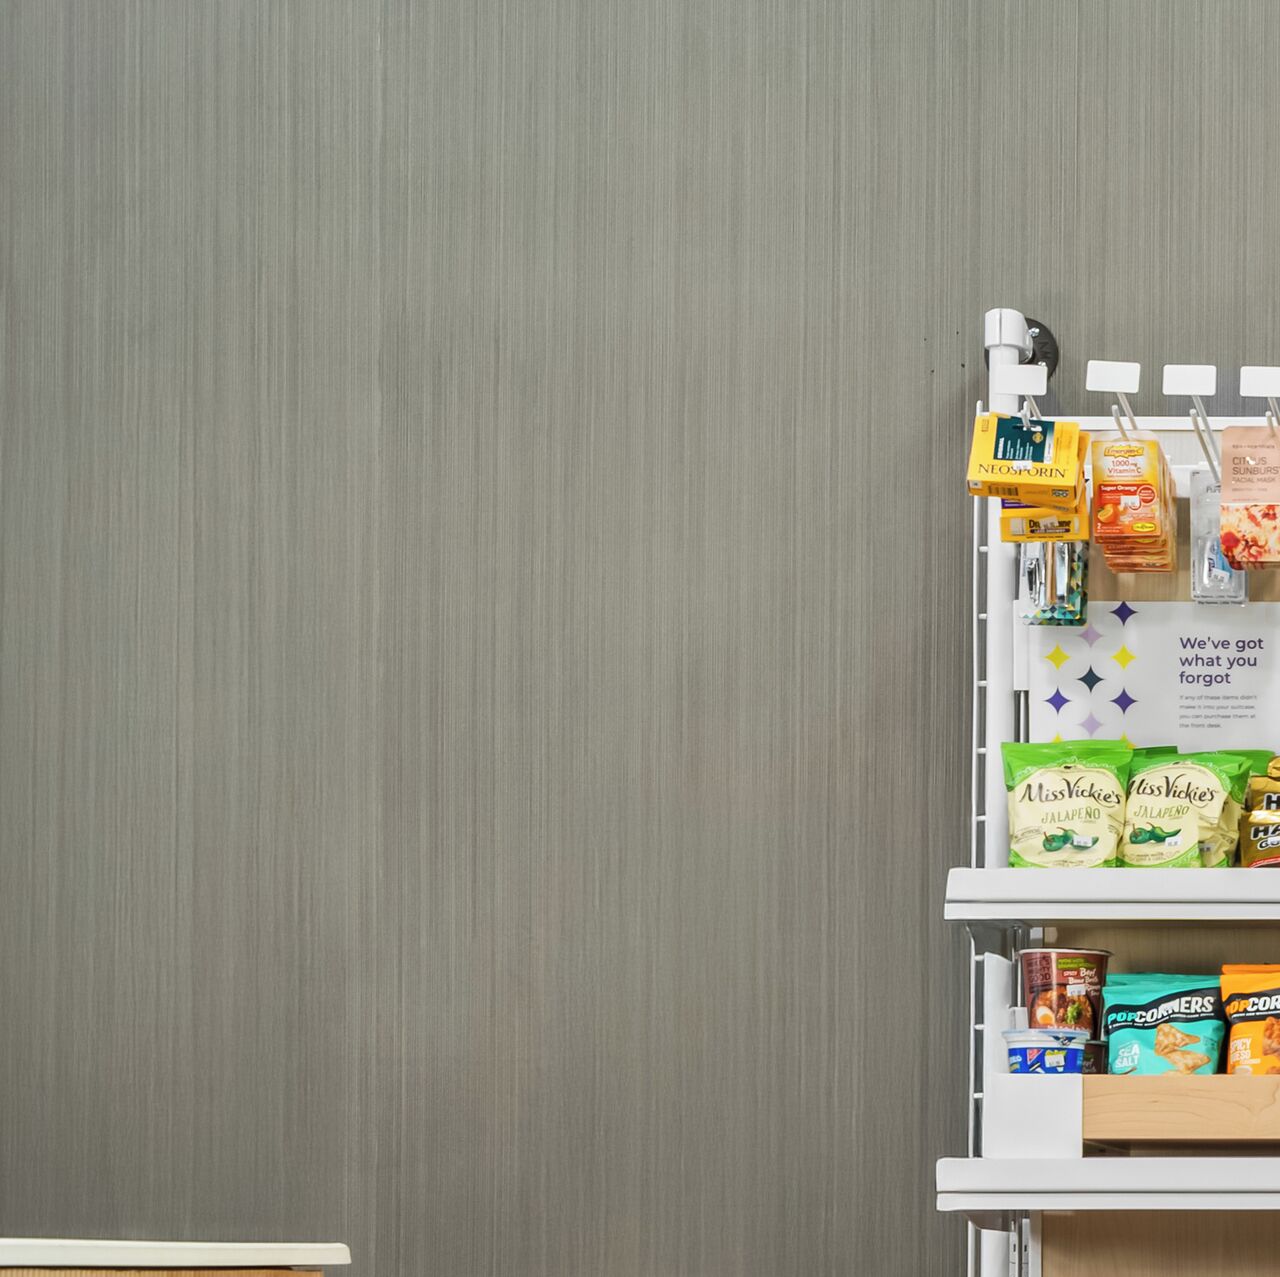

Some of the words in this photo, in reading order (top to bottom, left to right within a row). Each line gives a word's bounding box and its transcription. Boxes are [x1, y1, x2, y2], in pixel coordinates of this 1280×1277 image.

[978, 463, 1066, 478] NEOSPORIN
[1107, 467, 1135, 475] Vitamin
[1179, 637, 1230, 650] We've
[1236, 638, 1264, 653] got
[1179, 654, 1222, 667] what
[1227, 657, 1257, 670] you
[1179, 671, 1231, 687] forgot
[1019, 783, 1064, 804] Miss
[1064, 776, 1122, 809] Vickie's
[1161, 774, 1218, 809] Vickie's
[1041, 806, 1101, 825] JALAPEÑO
[1133, 804, 1190, 820] JALAPEÑO
[1107, 996, 1214, 1024] POPCORNERS
[1116, 1055, 1139, 1068] SALT
